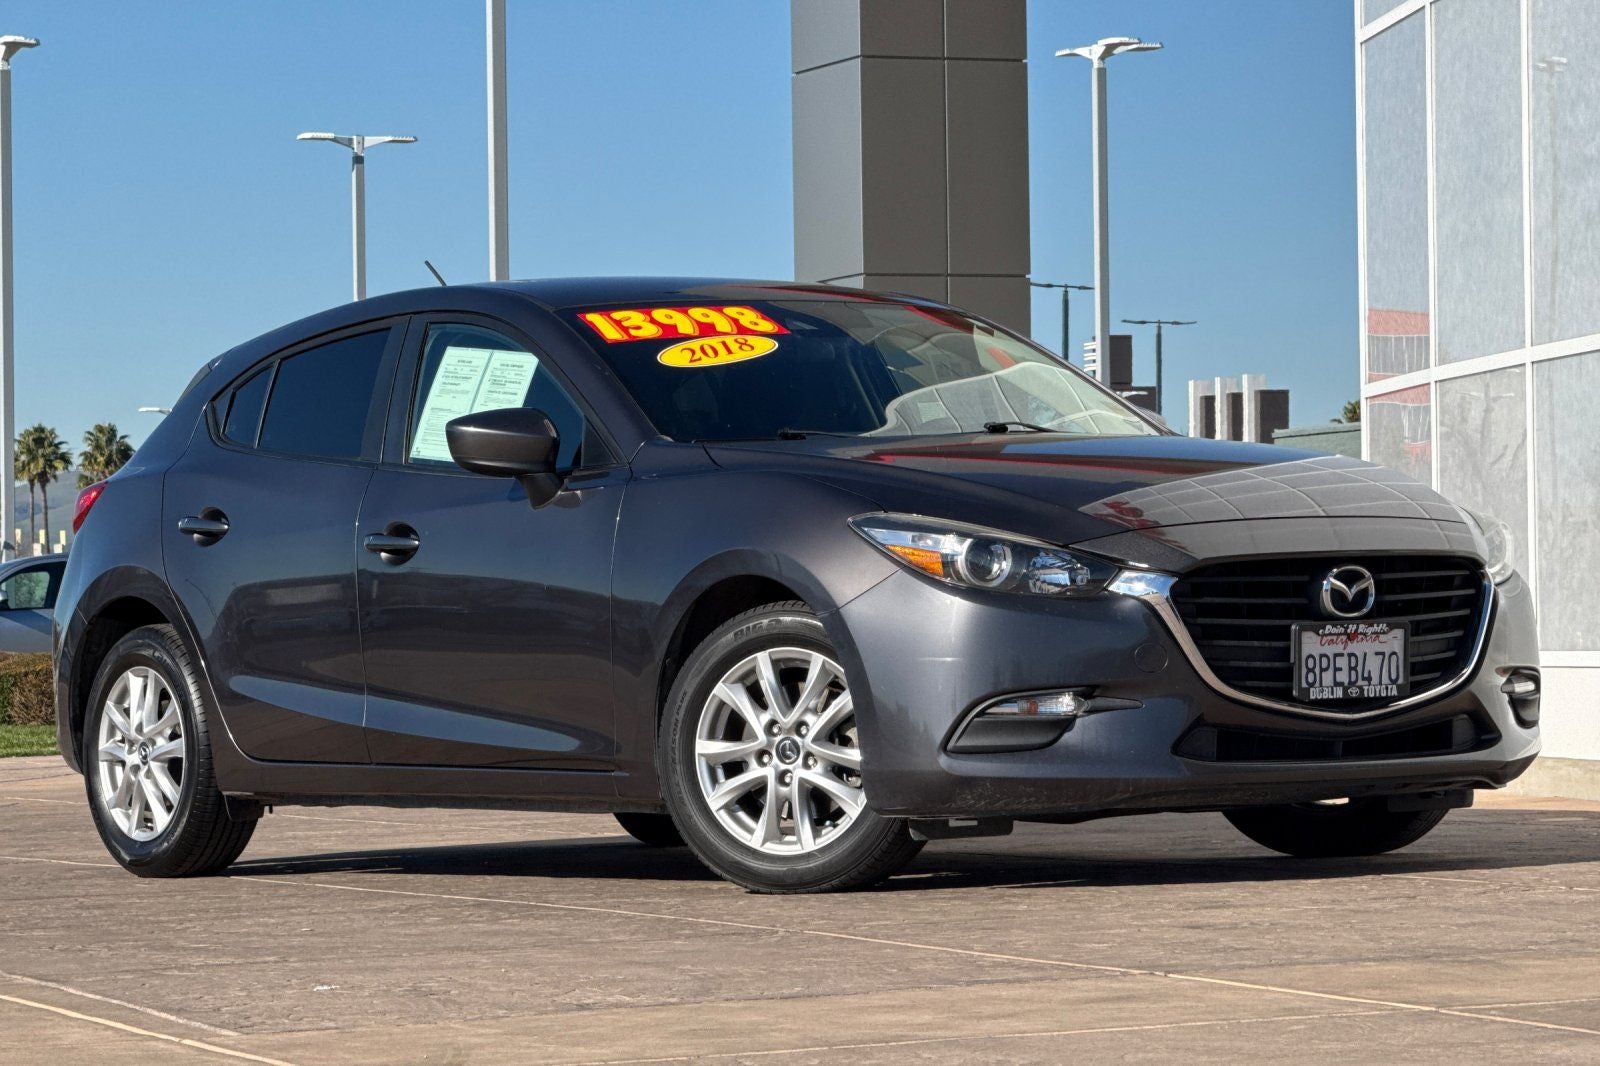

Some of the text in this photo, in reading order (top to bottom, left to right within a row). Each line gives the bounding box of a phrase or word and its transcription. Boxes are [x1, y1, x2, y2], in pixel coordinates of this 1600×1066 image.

[584, 306, 779, 341] 13998
[680, 337, 755, 364] 2018
[1320, 634, 1388, 650] Califrnia
[1304, 651, 1400, 688] 8PEB470
[1310, 684, 1398, 699] DUBLIN TOYOTA
